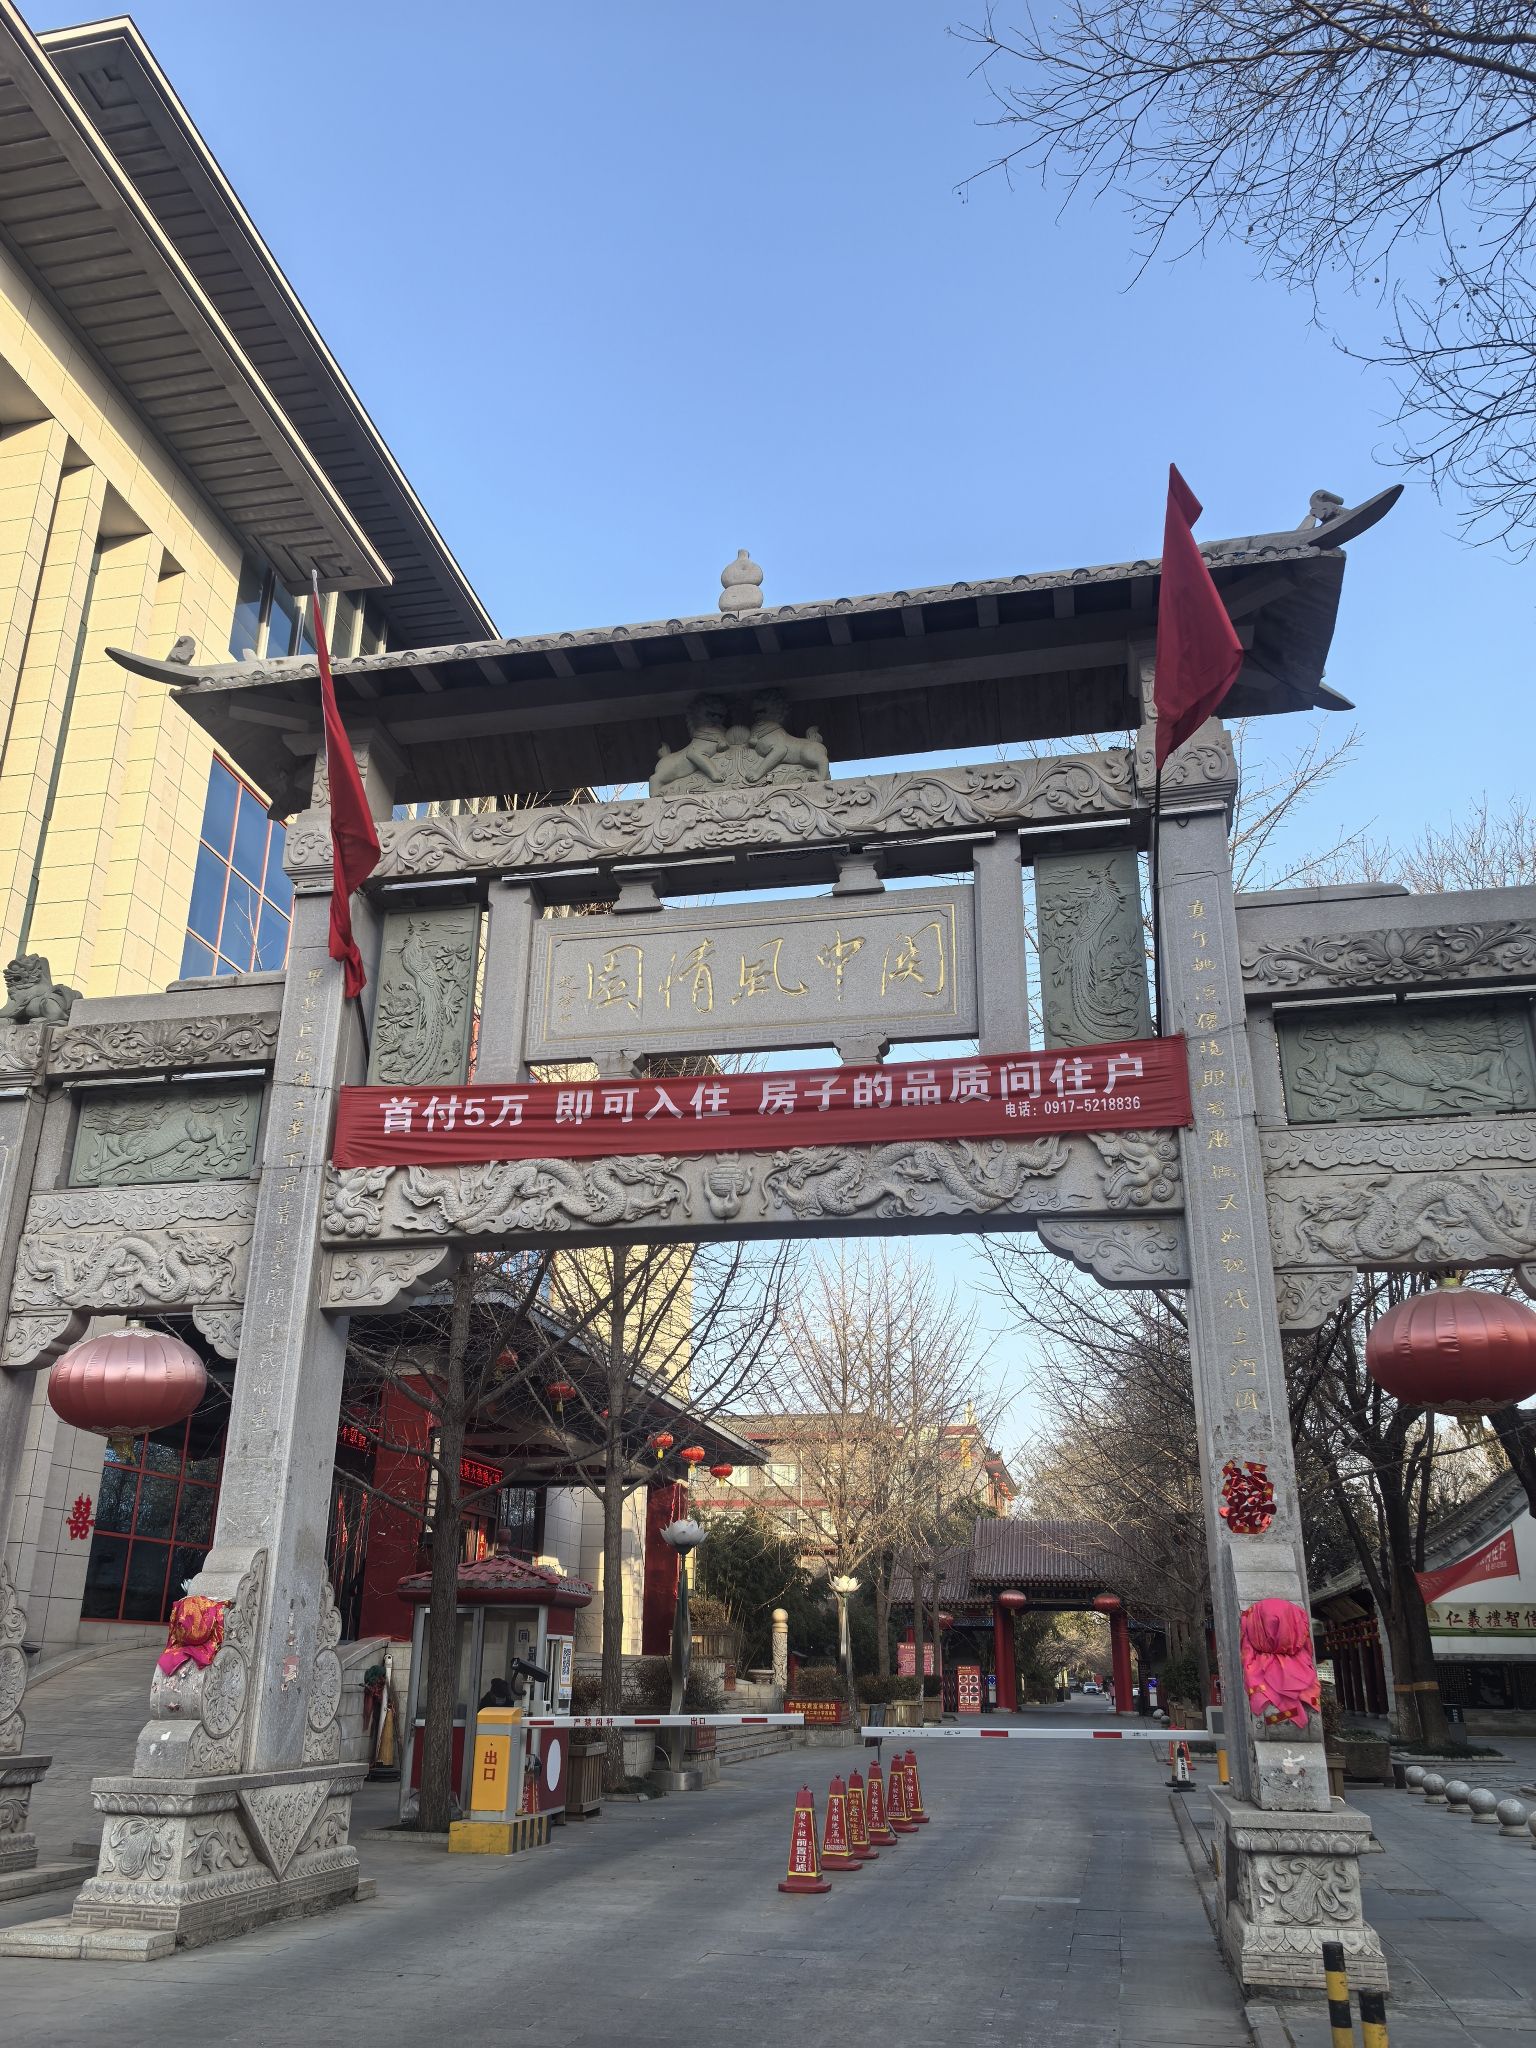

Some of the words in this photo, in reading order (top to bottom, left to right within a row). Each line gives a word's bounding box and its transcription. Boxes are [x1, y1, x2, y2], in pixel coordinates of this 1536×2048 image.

[379, 1095, 530, 1134] 首付5万
[553, 1081, 731, 1126] 即可入住
[757, 1053, 1144, 1116] 房子的品质问住户
[65, 1492, 96, 1541] 囍
[690, 1716, 706, 1726] 出口
[483, 1750, 497, 1781] 出口
